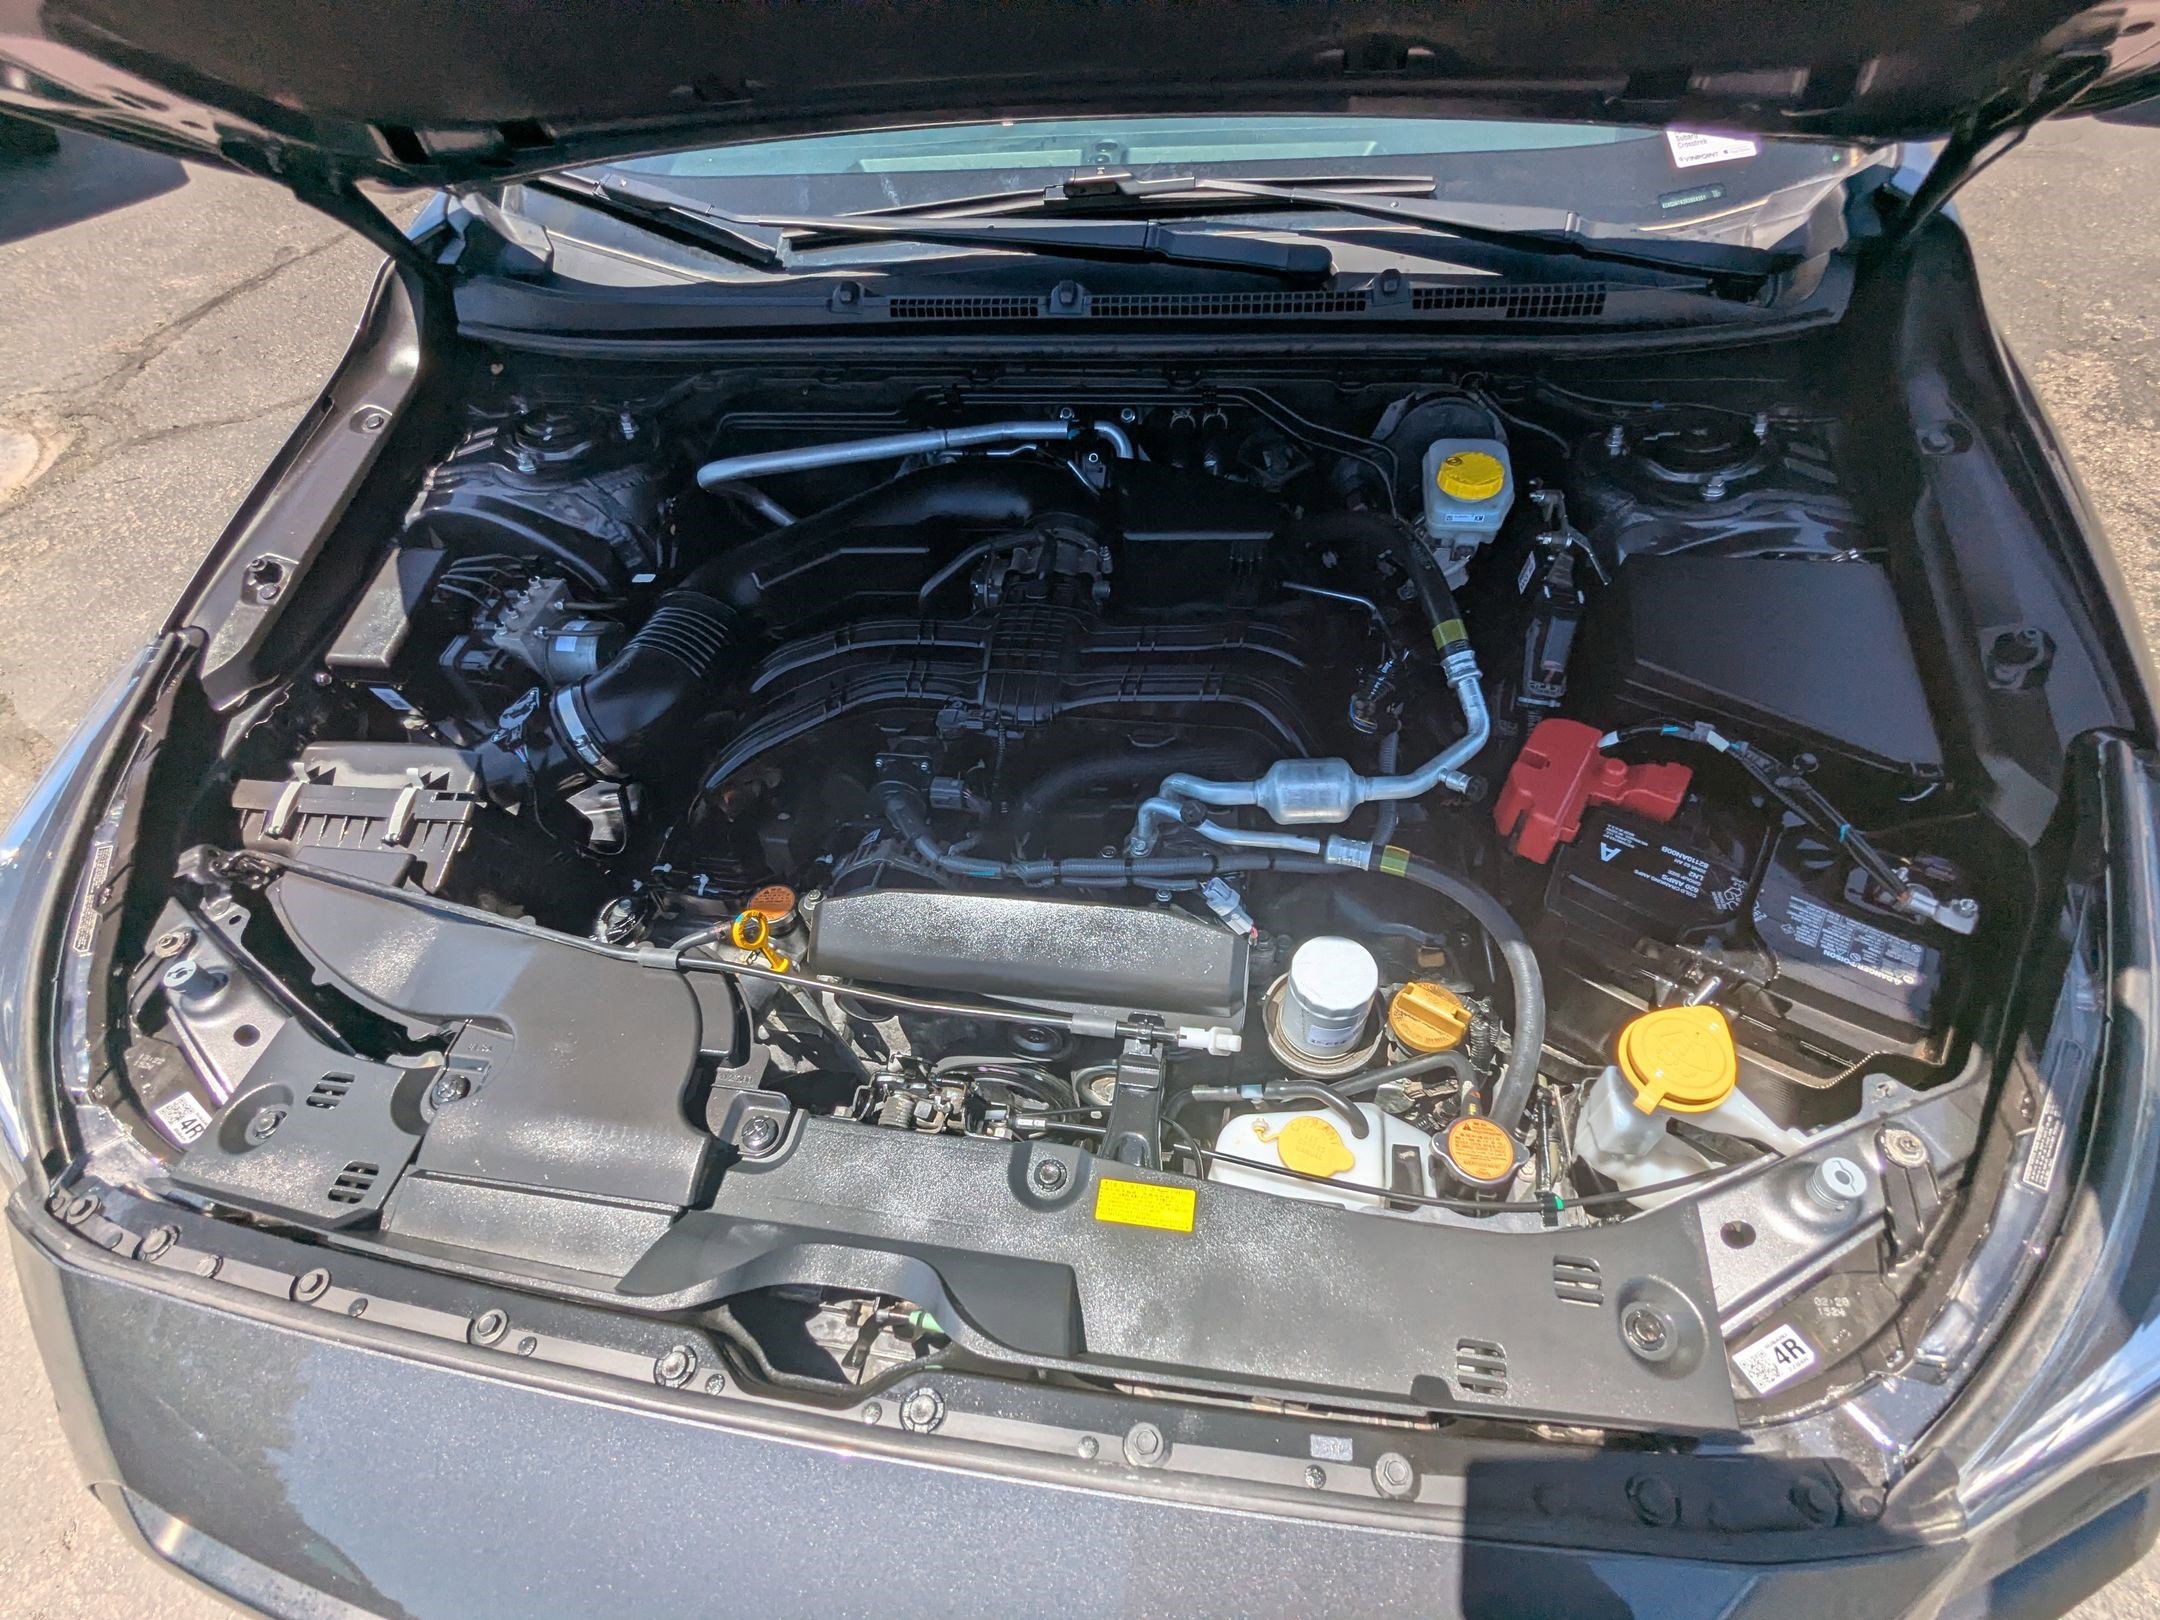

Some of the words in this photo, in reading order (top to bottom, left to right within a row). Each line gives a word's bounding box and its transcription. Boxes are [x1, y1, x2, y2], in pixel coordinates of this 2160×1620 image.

[1633, 869, 1650, 879] AMPS
[1667, 869, 1681, 878] SIZE
[1688, 870, 1704, 881] LN2
[1650, 876, 1681, 891] CRANKING
[1661, 874, 1685, 887] AMPS
[1680, 875, 1702, 887] GROUP
[1680, 888, 1697, 898] COLD
[1684, 883, 1699, 893] 620
[181, 1118, 205, 1140] 4R
[1774, 1338, 1806, 1364] 4R
